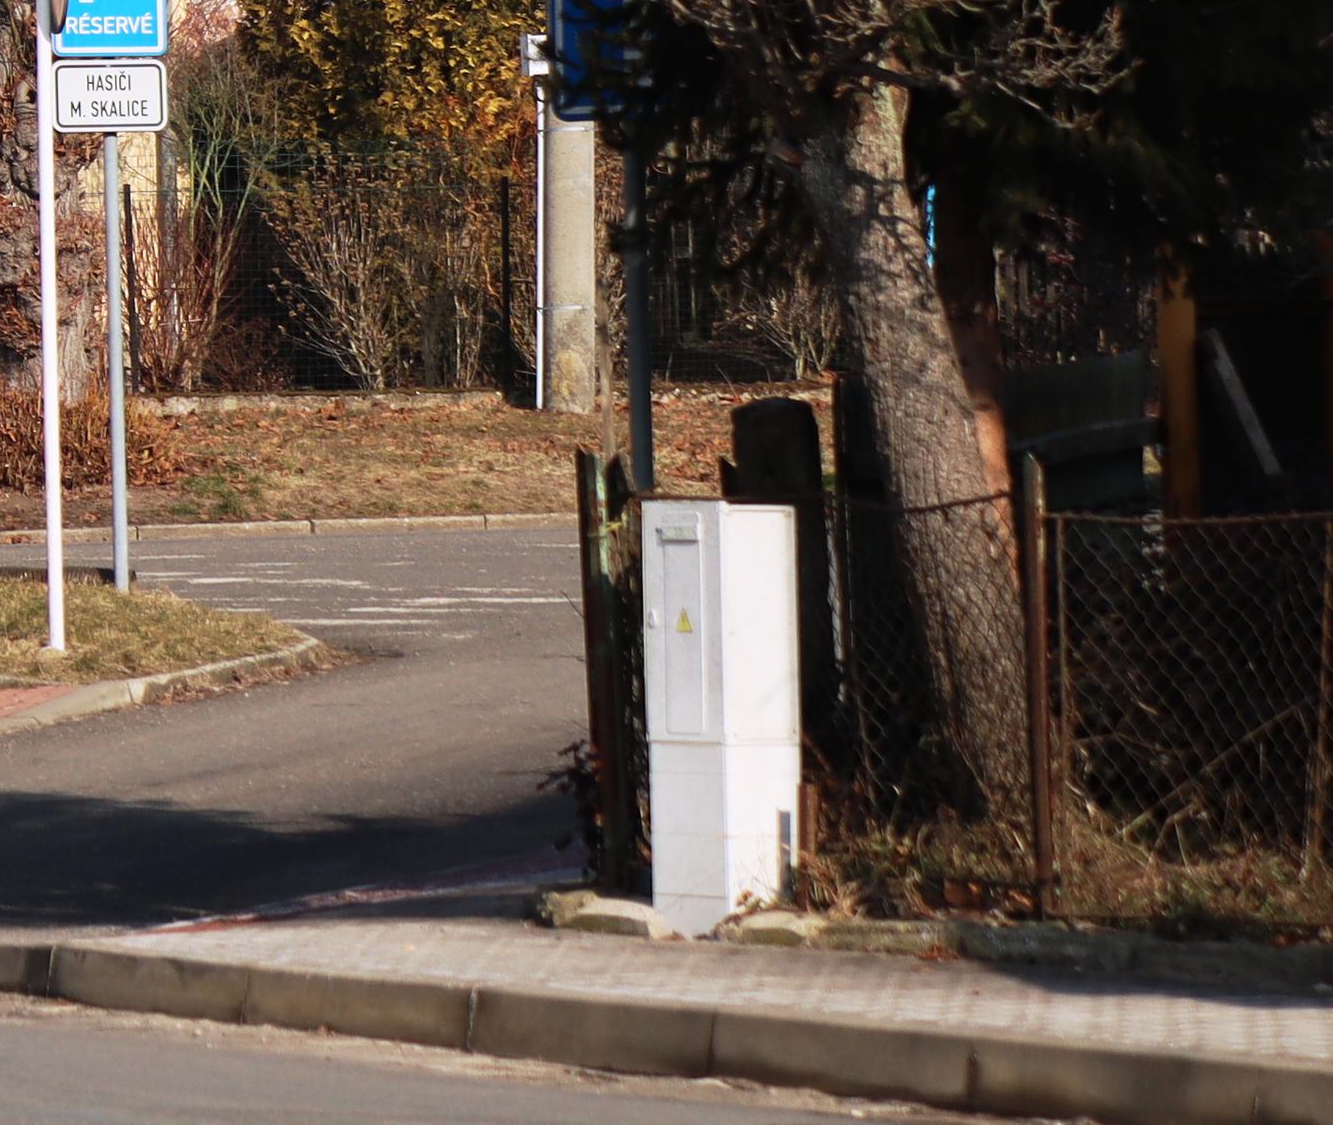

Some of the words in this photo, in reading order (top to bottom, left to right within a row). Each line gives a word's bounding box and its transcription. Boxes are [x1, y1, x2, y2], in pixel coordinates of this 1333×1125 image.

[66, 13, 153, 34] RÉSERVÉ
[86, 71, 131, 91] HASIČI
[70, 101, 86, 118] M.
[91, 99, 148, 117] SKALICE
